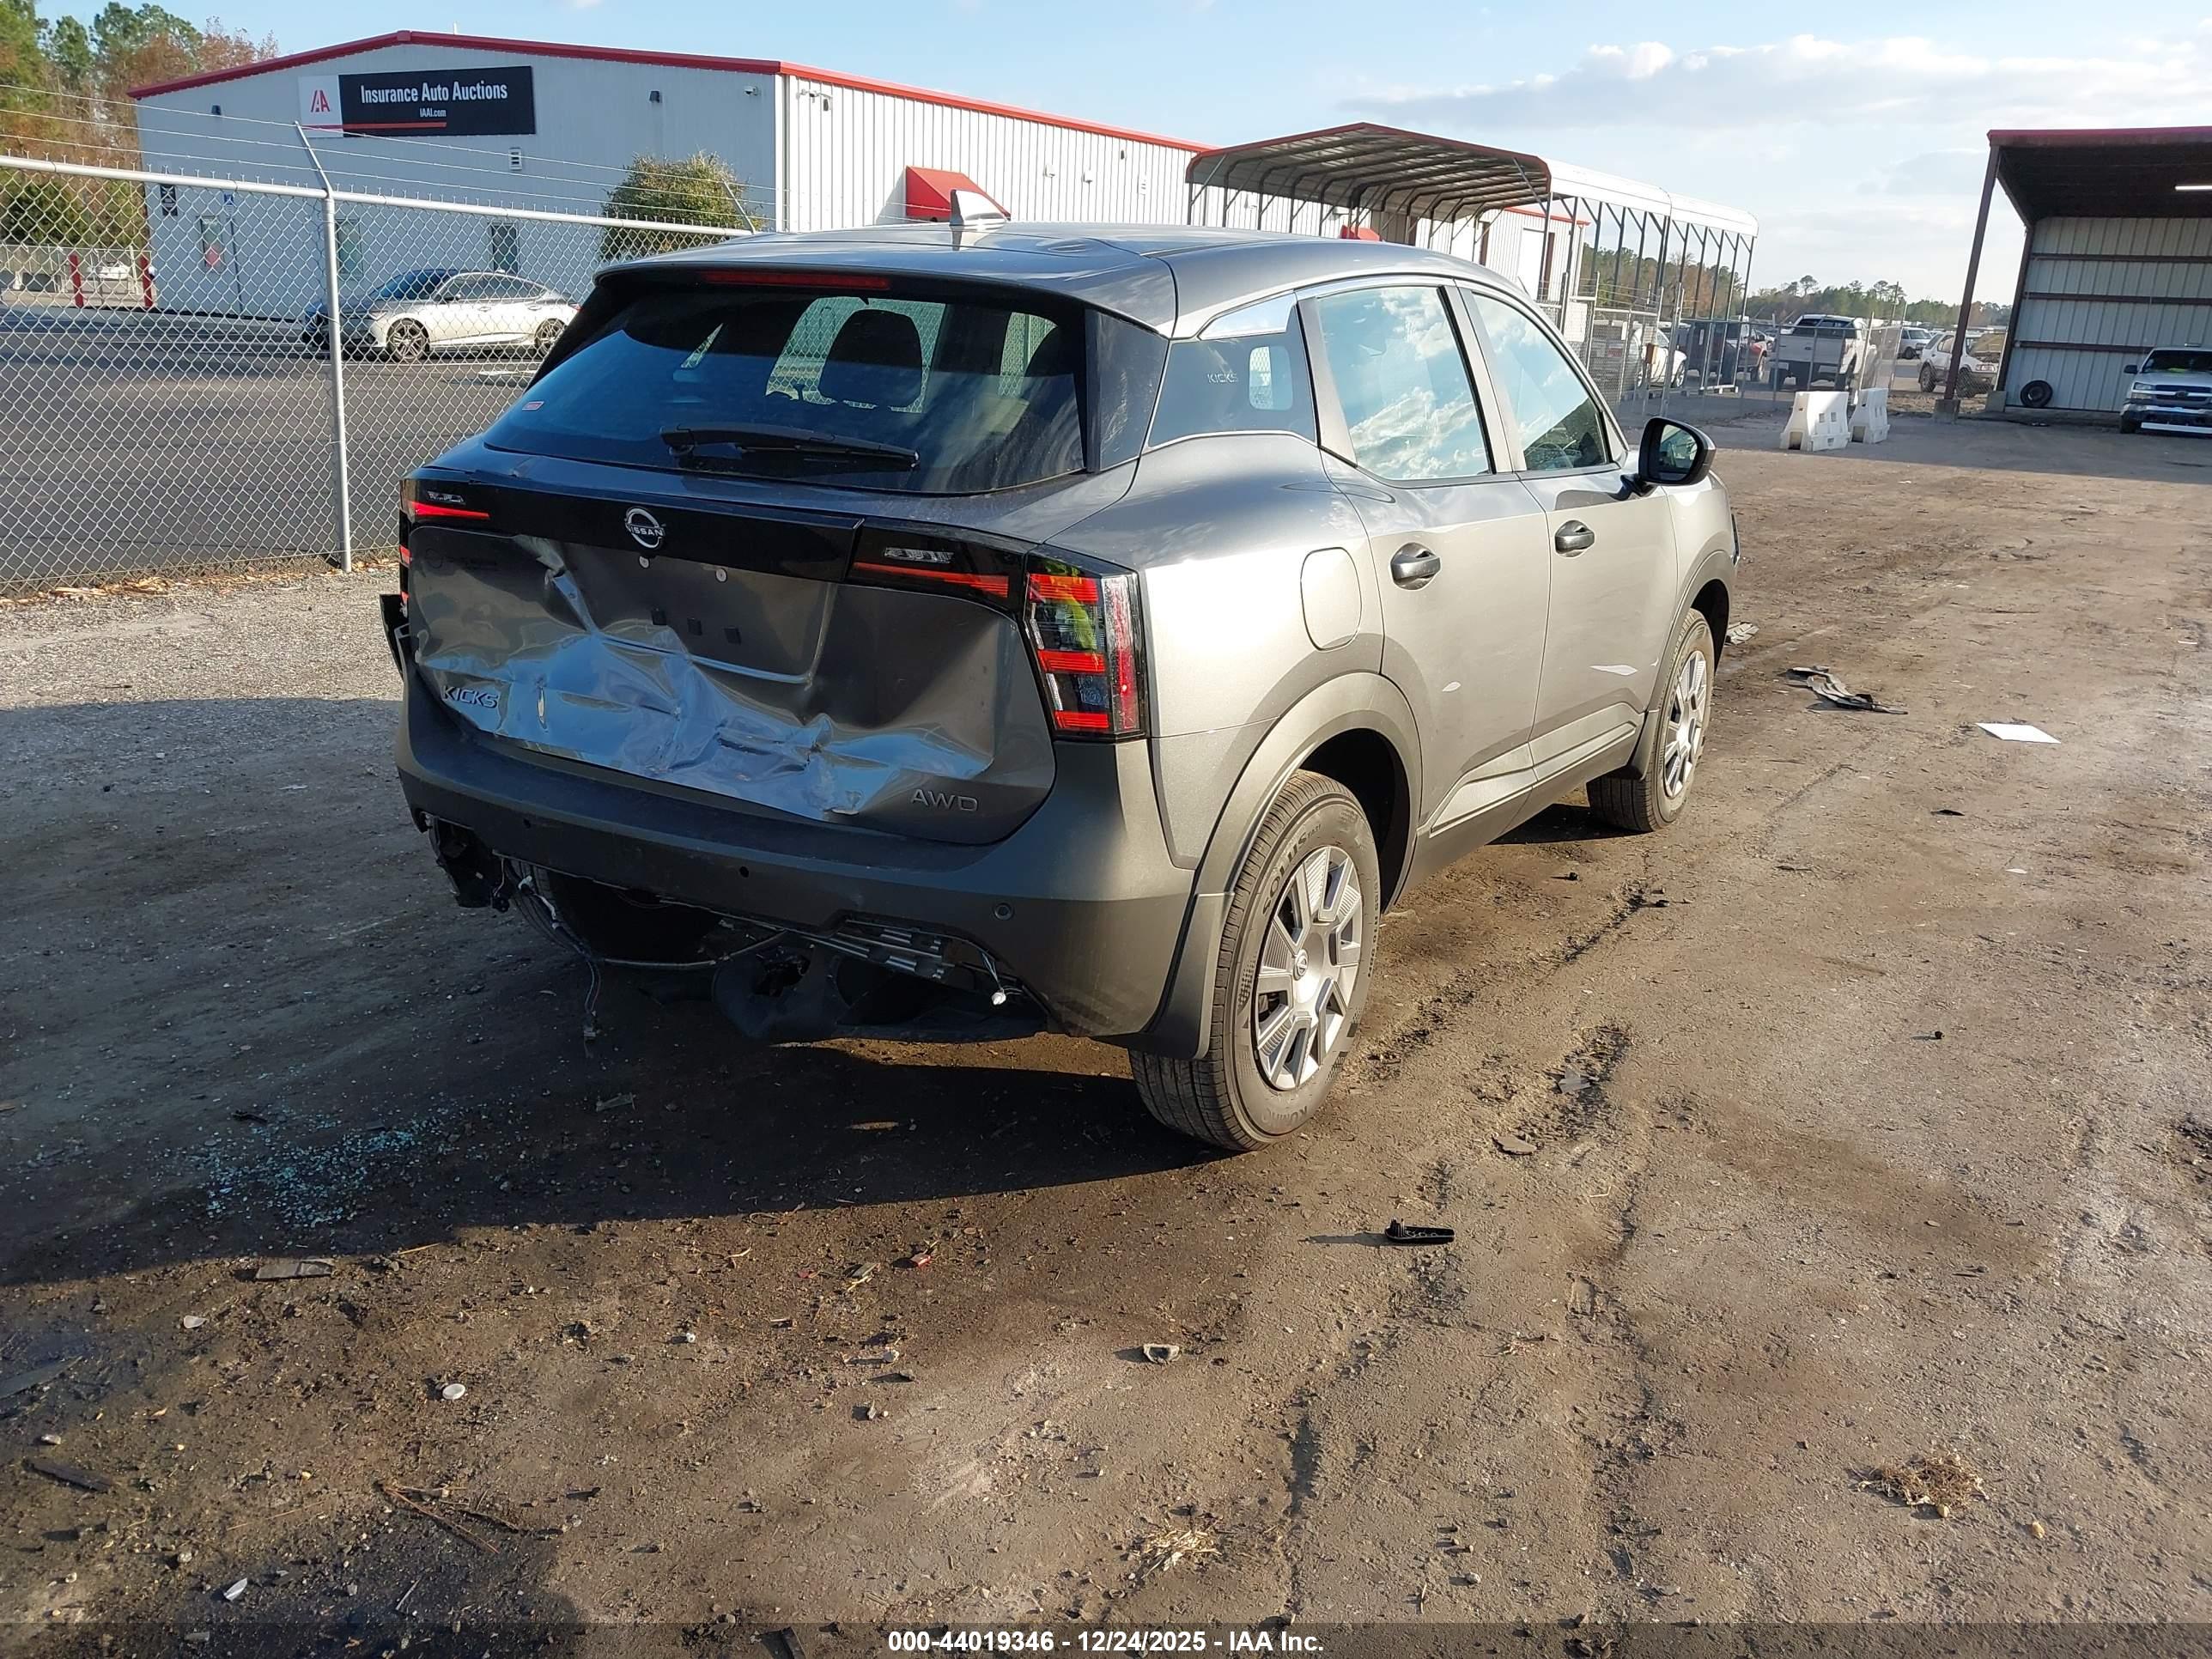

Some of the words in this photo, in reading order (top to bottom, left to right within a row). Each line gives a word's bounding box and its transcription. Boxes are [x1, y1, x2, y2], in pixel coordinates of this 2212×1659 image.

[361, 85, 418, 104] Insurance
[422, 82, 449, 101] Auto
[452, 81, 508, 100] Auctions
[1207, 373, 1237, 383] KICKS
[441, 685, 499, 708] KICKS
[910, 788, 978, 811] AWD
